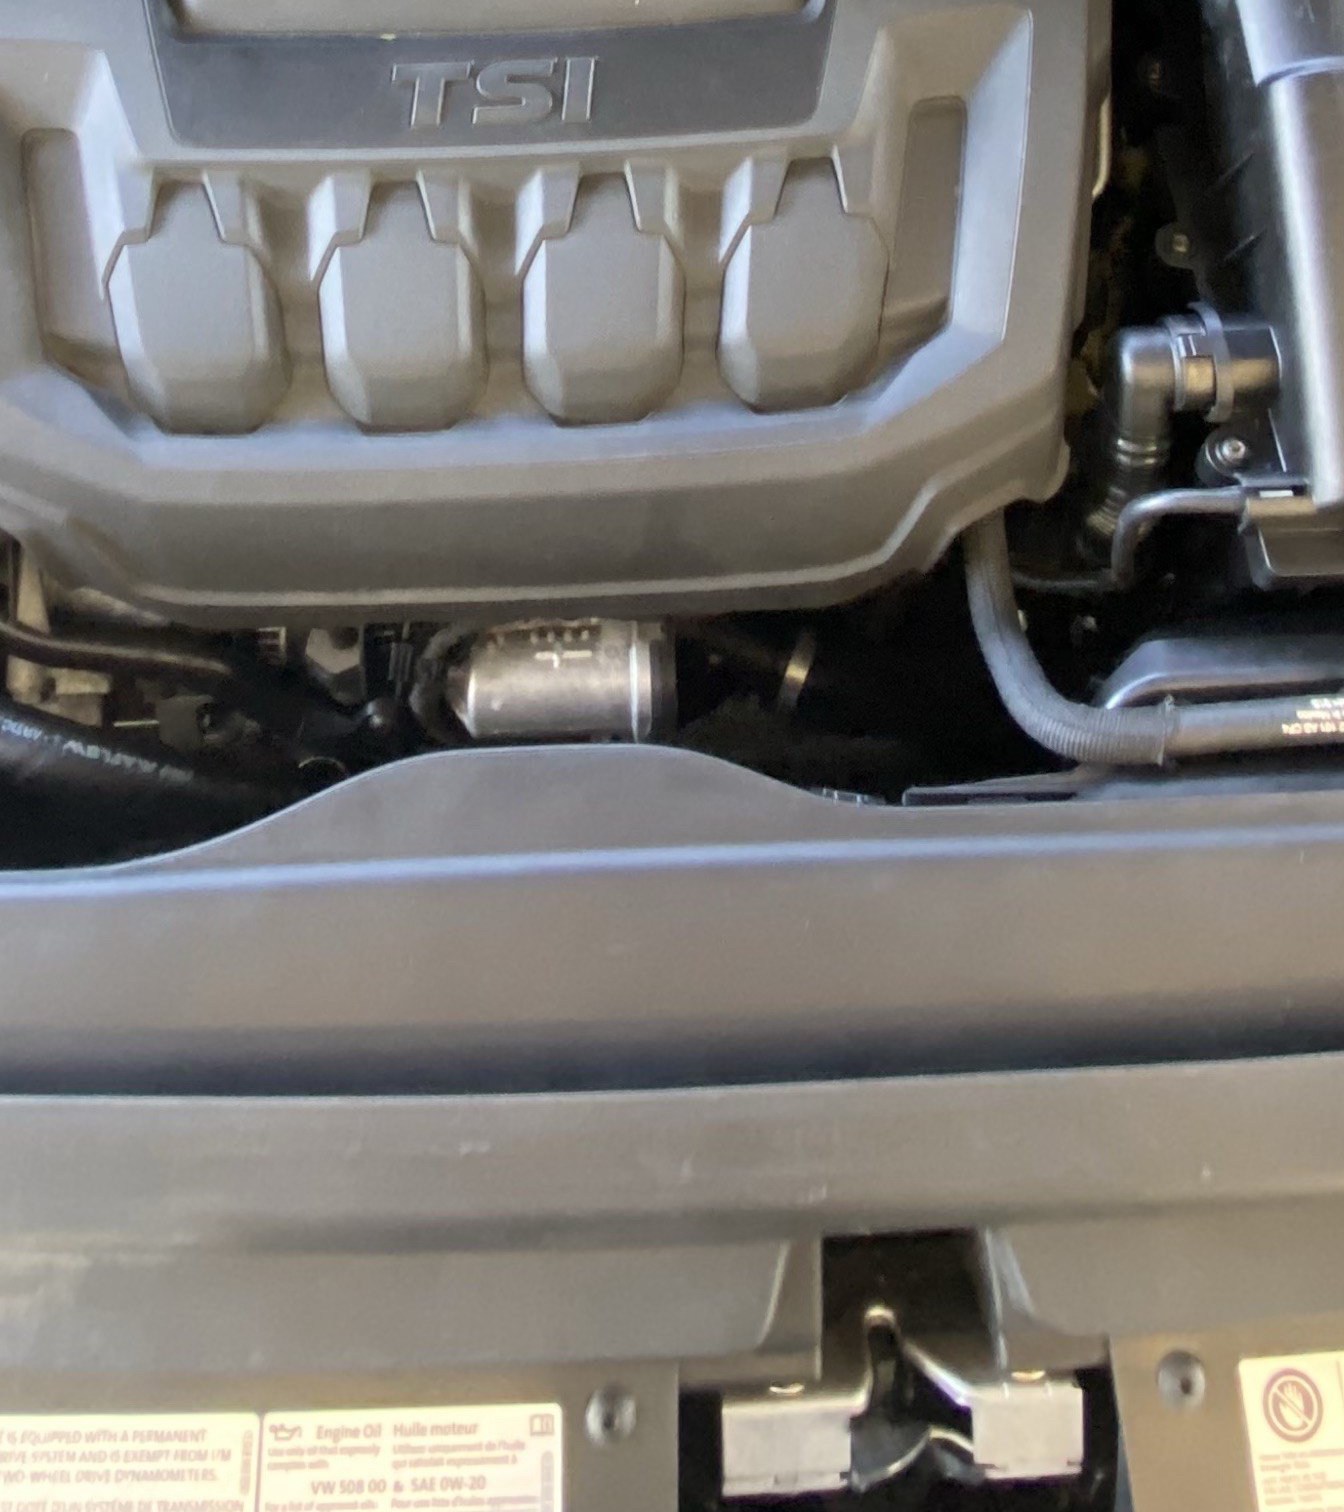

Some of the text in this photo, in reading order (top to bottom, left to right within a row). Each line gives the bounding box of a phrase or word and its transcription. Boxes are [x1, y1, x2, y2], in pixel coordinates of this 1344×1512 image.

[391, 56, 599, 128] TSI
[131, 1427, 208, 1443] PERMANENT
[316, 1422, 382, 1443] Engine Oil
[392, 1422, 479, 1438] Huile moteur
[311, 1480, 338, 1495] VW
[339, 1479, 366, 1494] 508
[367, 1478, 387, 1494] 00
[410, 1476, 437, 1492] SAE
[439, 1475, 487, 1492] 0W-20
